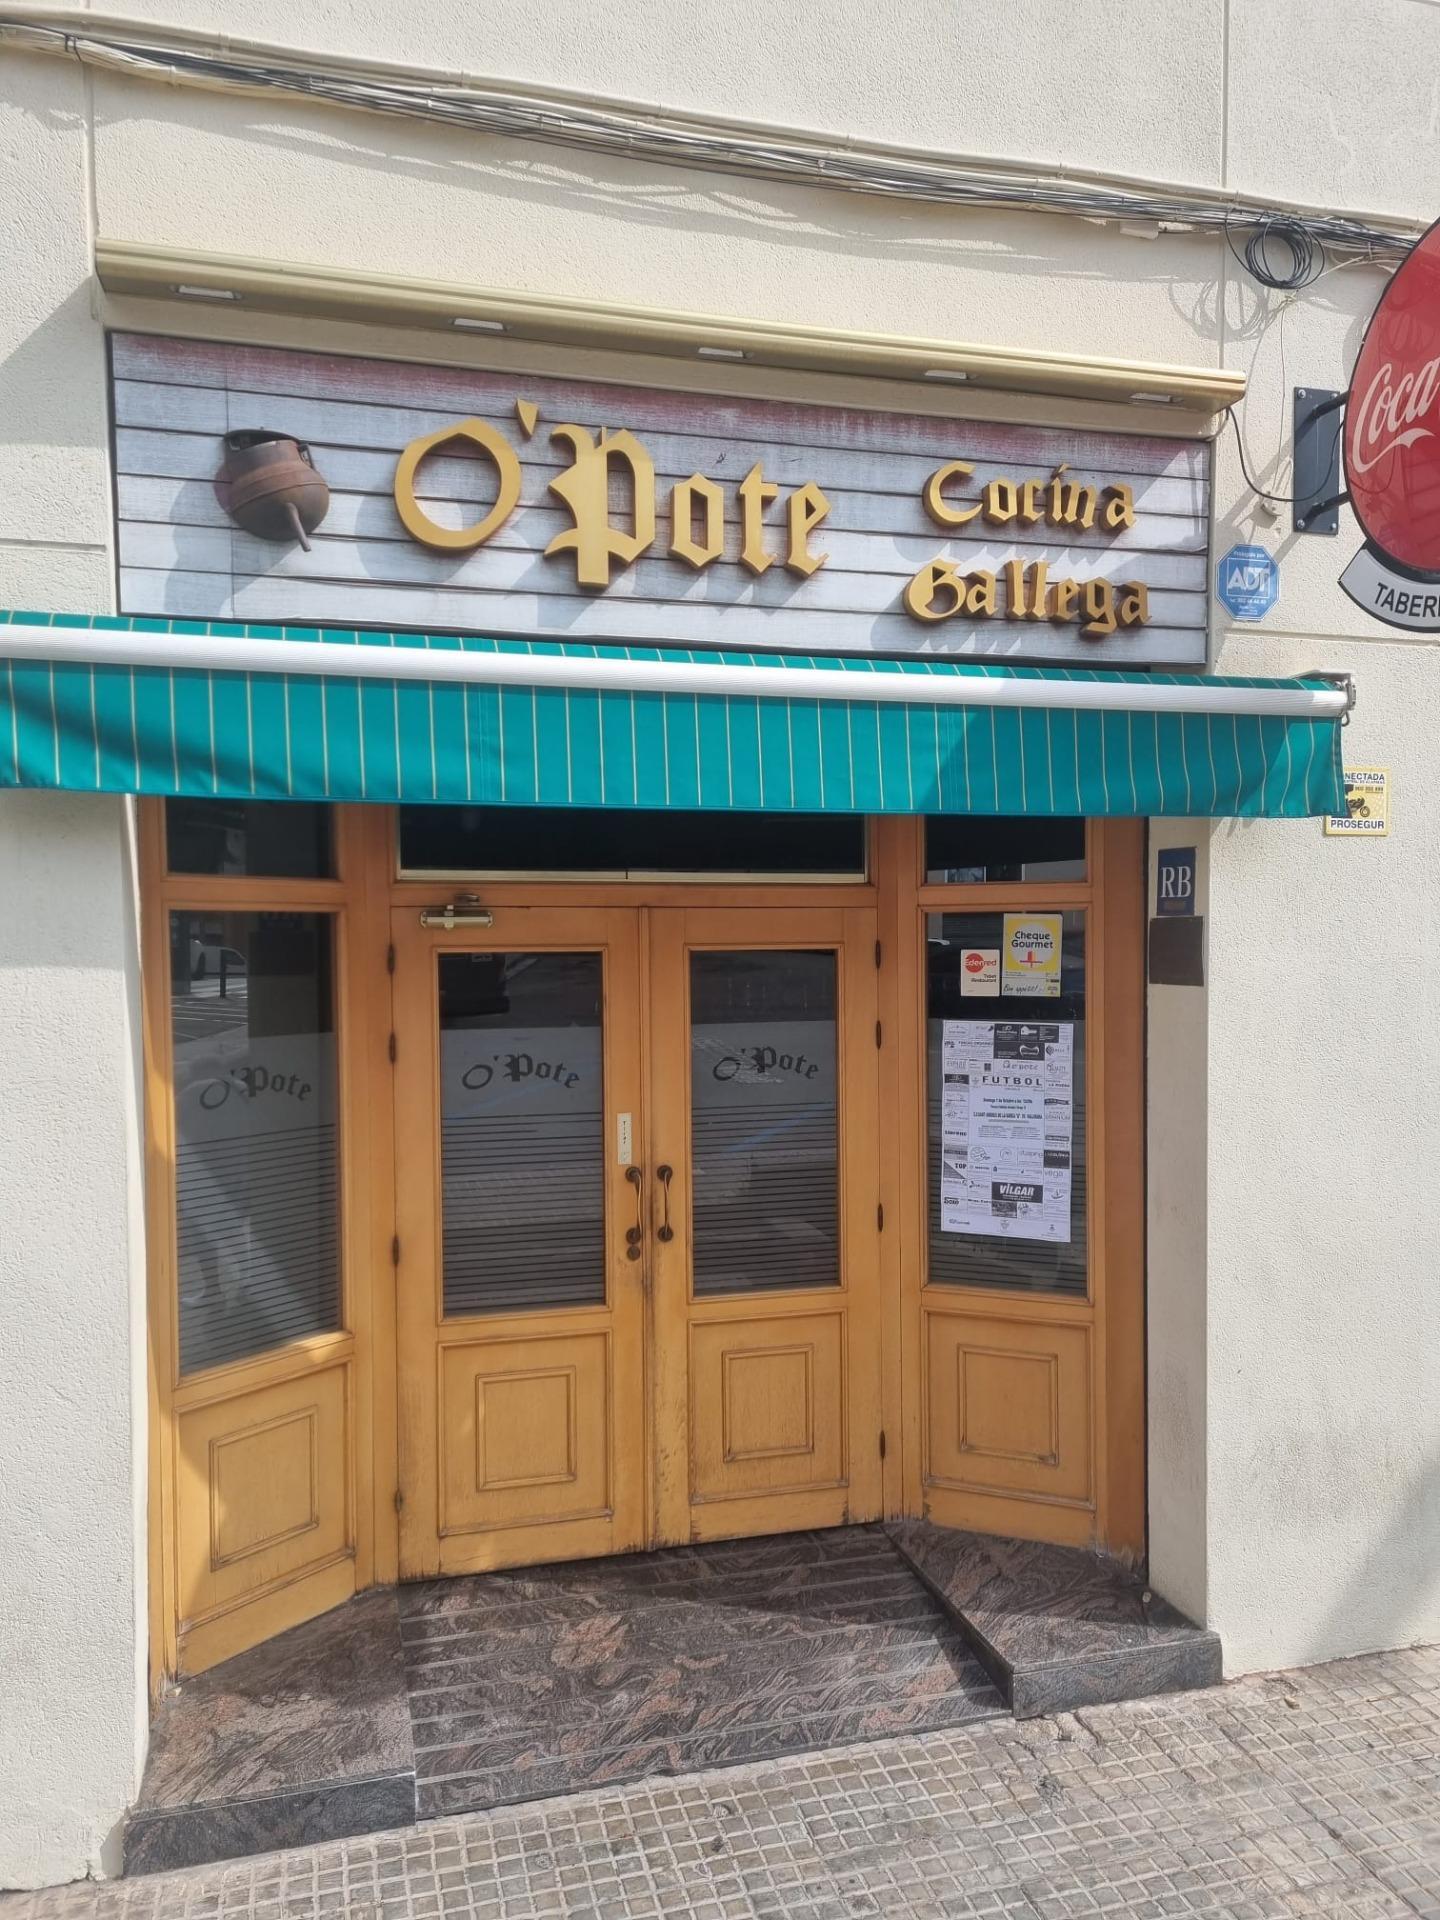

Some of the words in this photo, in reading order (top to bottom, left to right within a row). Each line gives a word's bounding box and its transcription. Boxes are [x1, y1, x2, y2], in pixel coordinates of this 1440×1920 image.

[1352, 356, 1440, 473] Coca
[1228, 566, 1270, 592] ADT
[904, 558, 1152, 637] Gallega
[1375, 582, 1440, 617] TABER
[1344, 773, 1385, 781] NECTADA
[1331, 820, 1384, 829] PROSEGUR
[1161, 865, 1192, 898] RB
[1011, 940, 1053, 948] Gourmet
[1014, 931, 1050, 941] Cheque
[965, 959, 997, 967] Edenred
[461, 1052, 580, 1090] O'Pote
[712, 1046, 819, 1081] O'Pote
[982, 1075, 1043, 1086] FUTBOL
